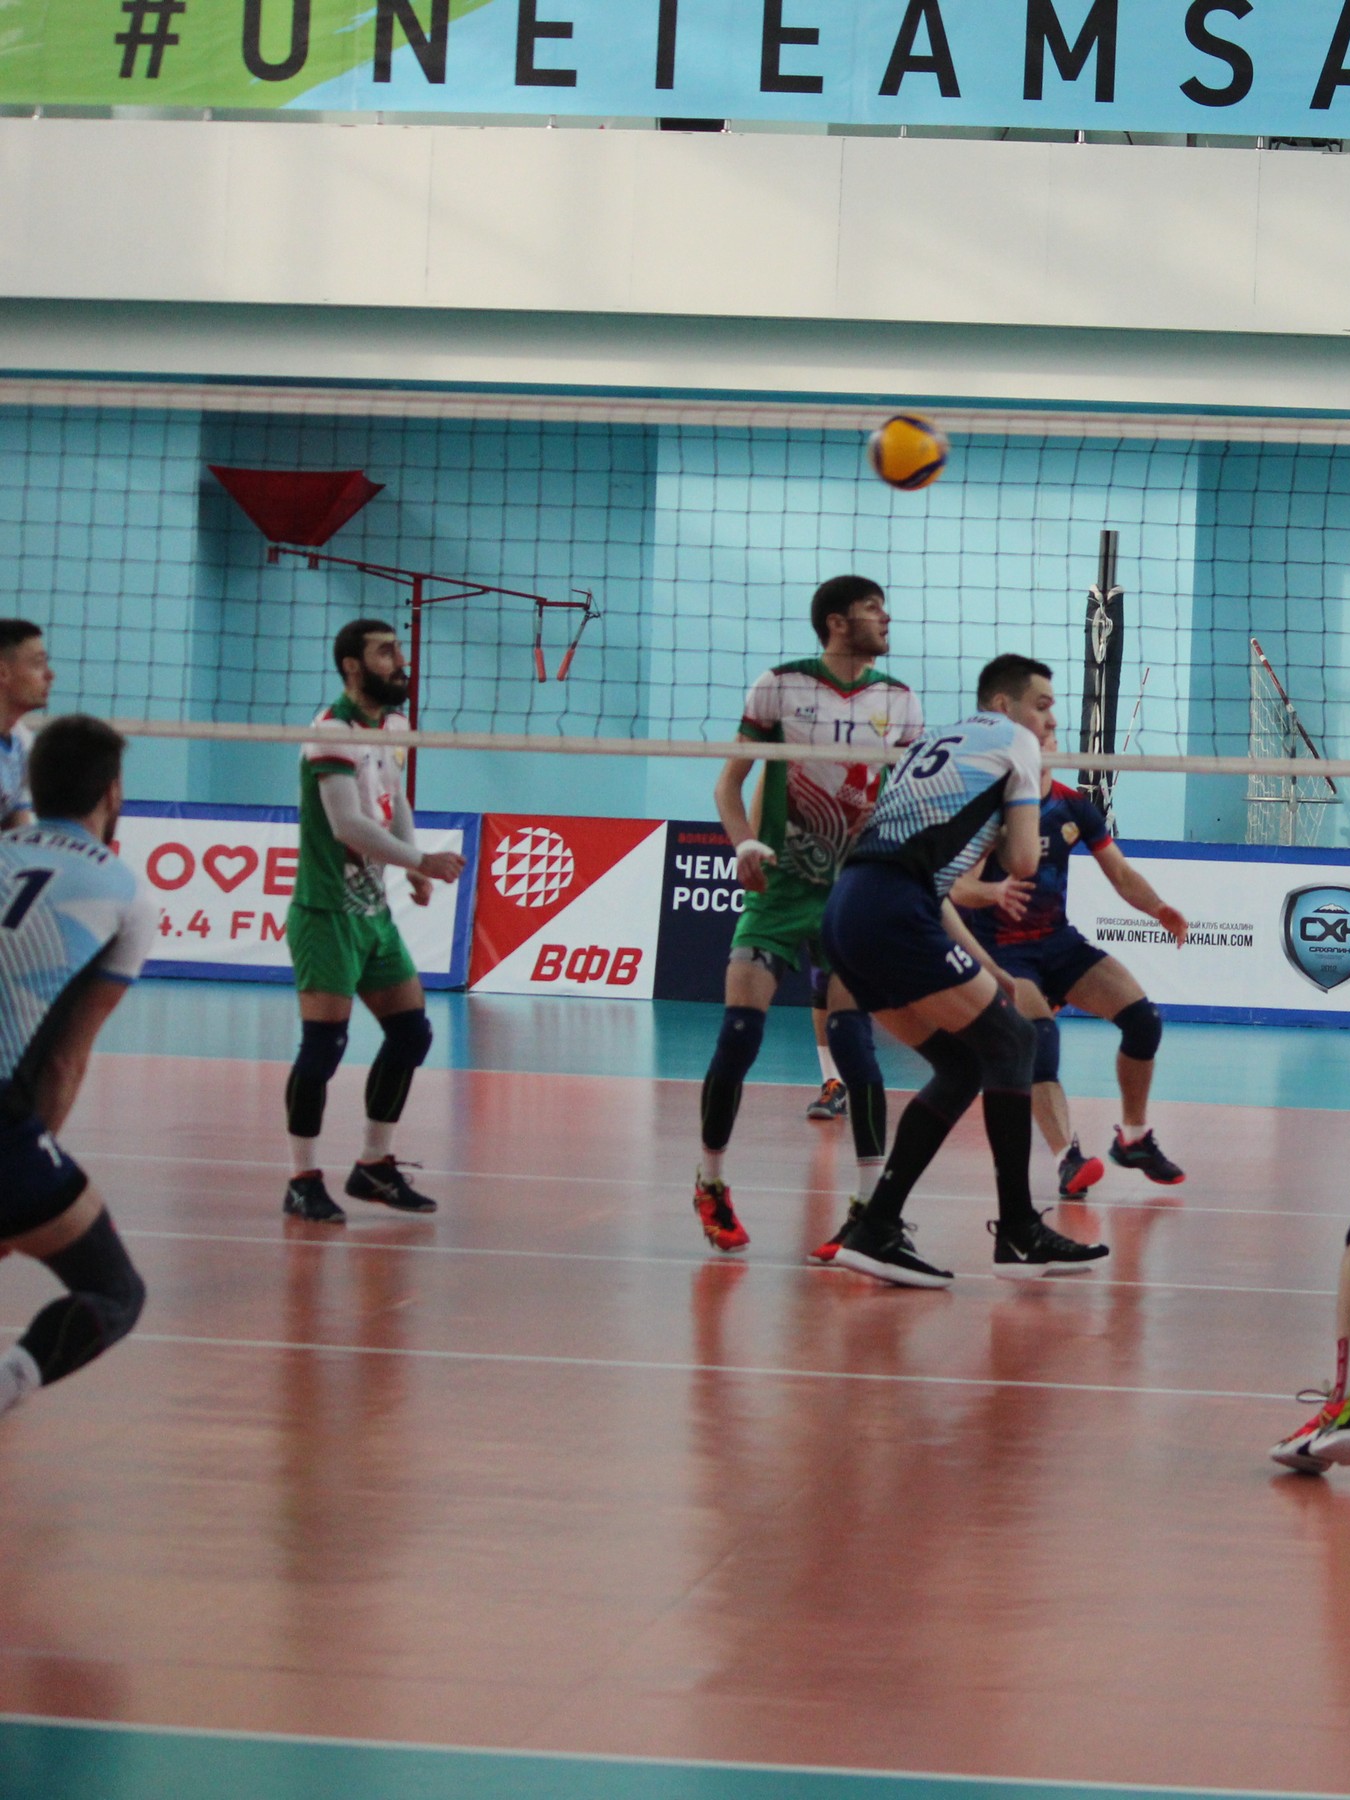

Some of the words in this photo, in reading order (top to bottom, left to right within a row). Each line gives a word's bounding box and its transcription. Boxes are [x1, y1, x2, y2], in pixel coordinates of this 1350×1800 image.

[894, 736, 963, 785] 15
[675, 855, 738, 880] ЧЕМ
[672, 886, 746, 912] РОСС
[1096, 929, 1253, 947] WWW.ONETEAMAKHALIN.COM
[530, 944, 643, 985] ВФВ
[946, 944, 973, 974] 15
